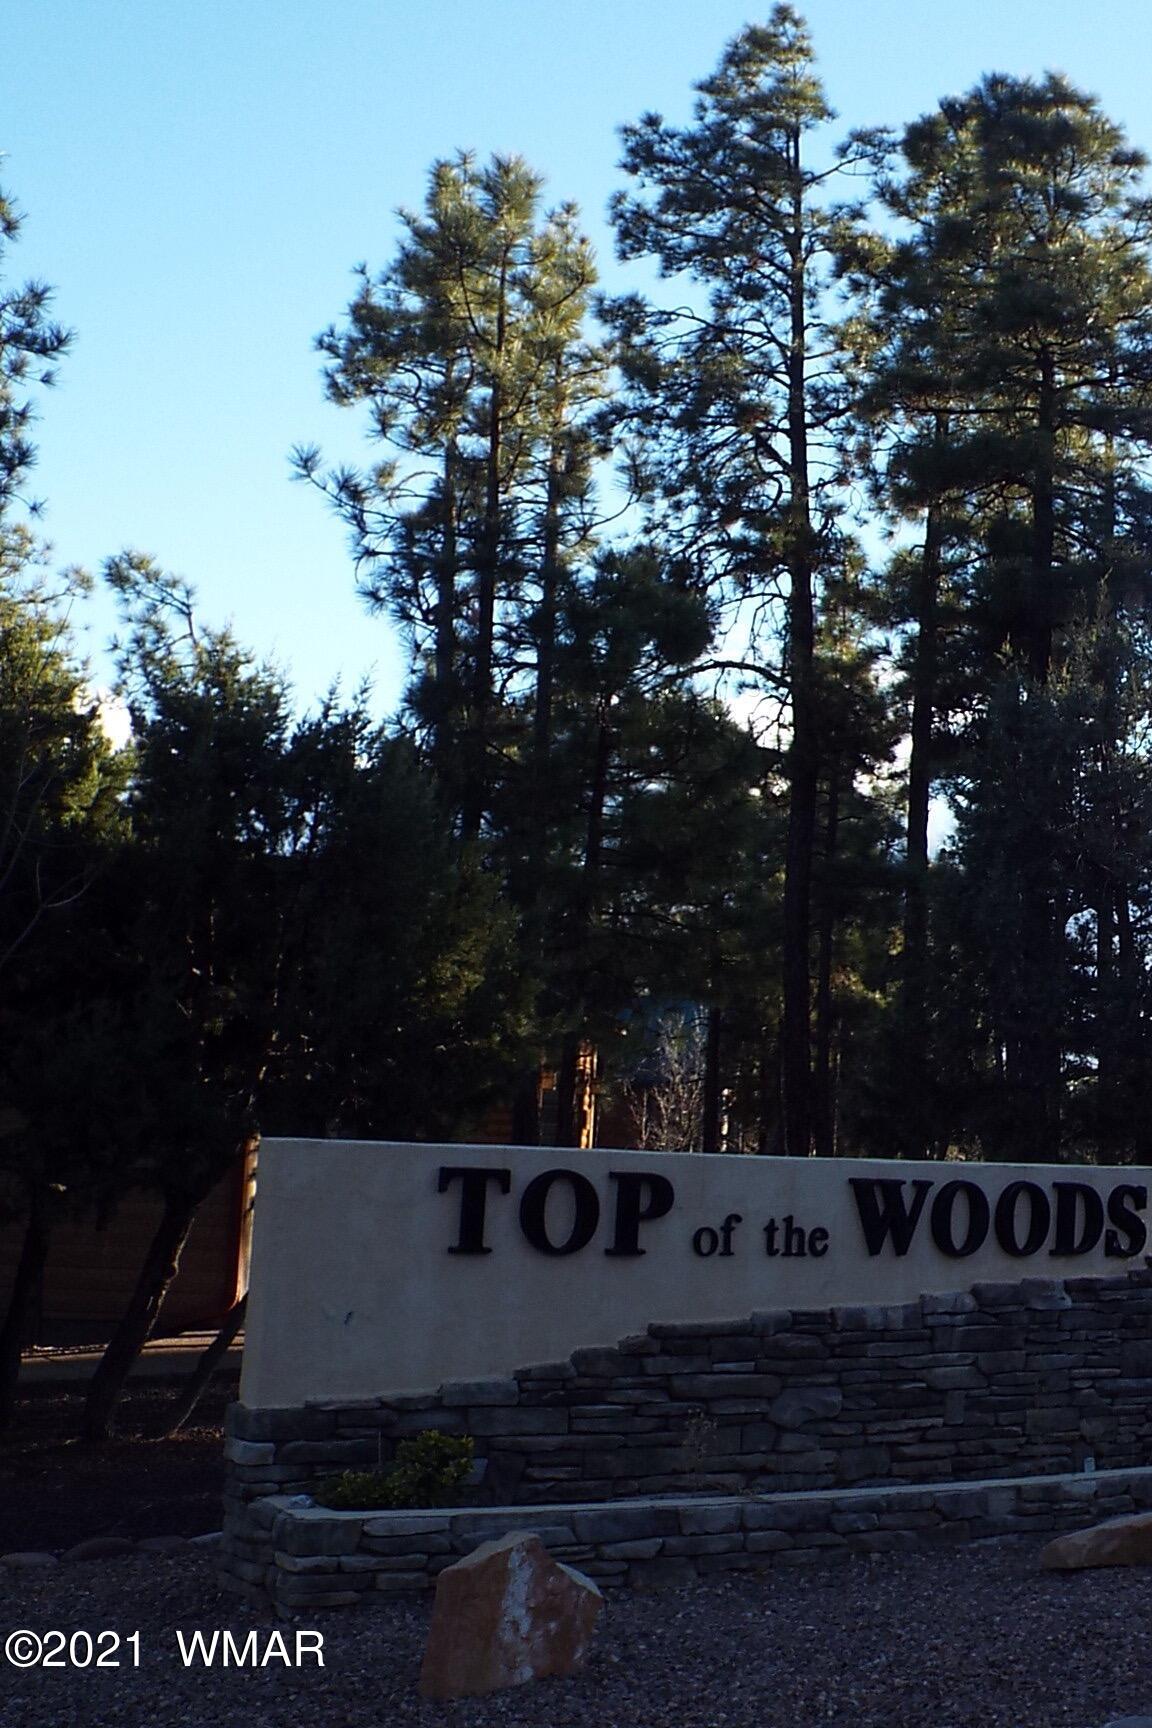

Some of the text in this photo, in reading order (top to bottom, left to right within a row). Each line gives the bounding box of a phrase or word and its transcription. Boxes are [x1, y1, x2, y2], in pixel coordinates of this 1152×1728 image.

[439, 1167, 1148, 1258] TOP of the WOODS
